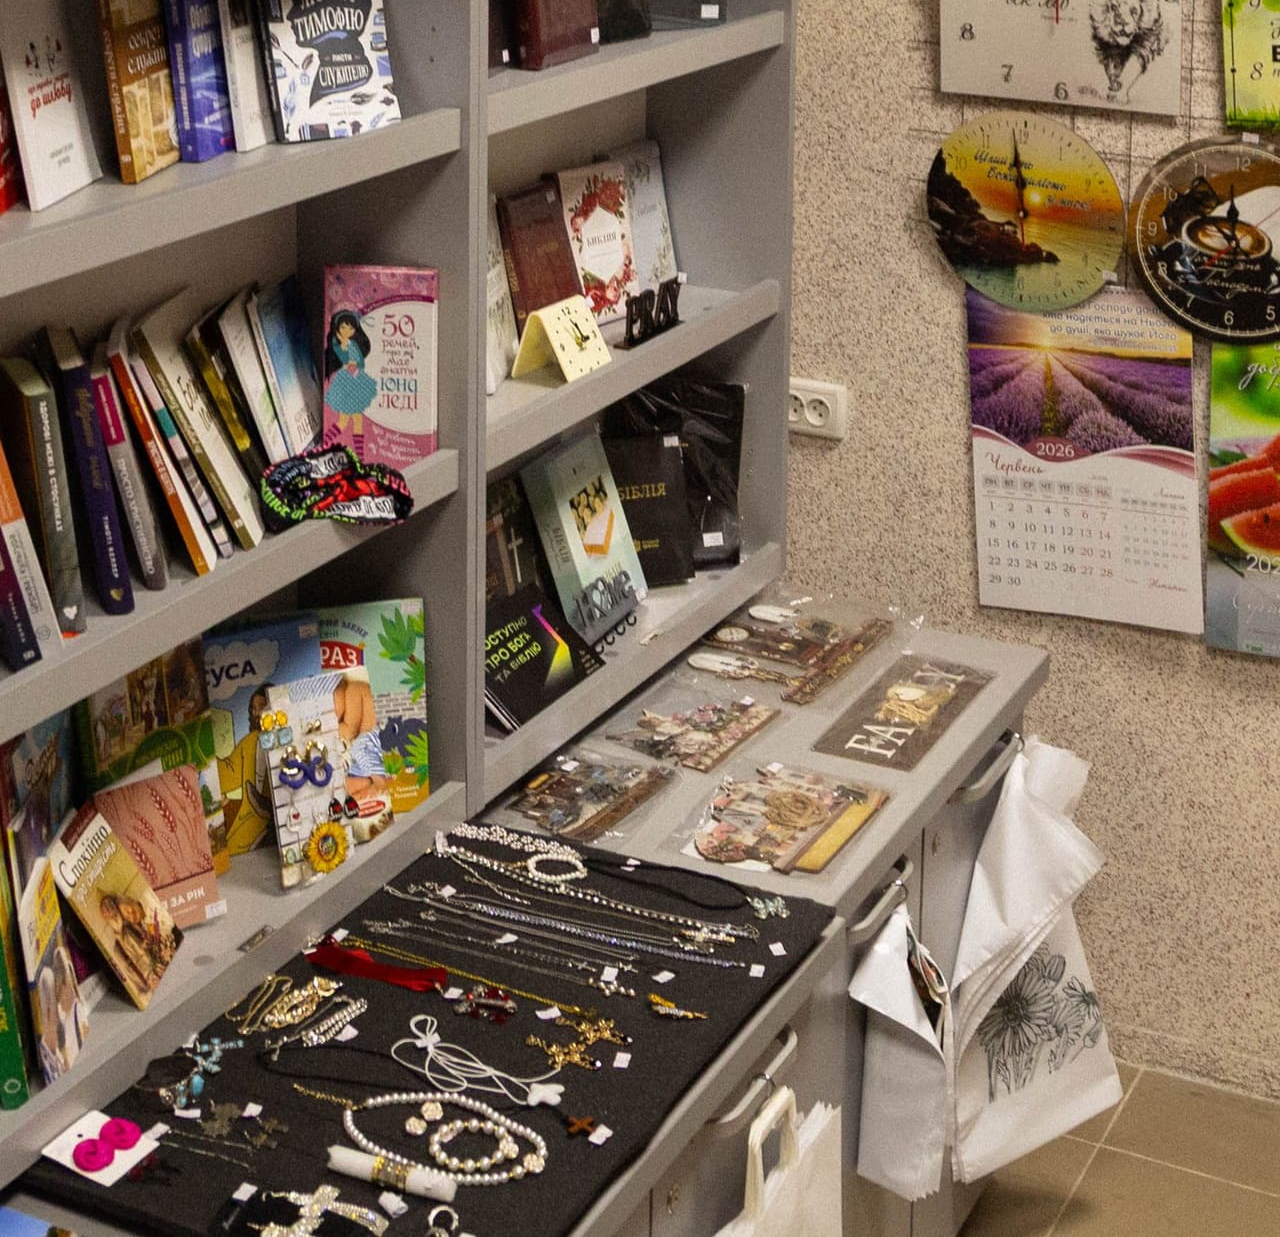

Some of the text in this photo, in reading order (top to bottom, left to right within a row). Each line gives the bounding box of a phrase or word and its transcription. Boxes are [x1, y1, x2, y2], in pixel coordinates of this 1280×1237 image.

[294, 6, 364, 41] ТИМОФІЮ
[319, 64, 369, 88] СЛУЖИТЕЛЮ
[624, 277, 682, 348] PRAY
[382, 314, 415, 338] 50
[1035, 441, 1075, 459] 2026
[988, 537, 1000, 549] 15
[1006, 539, 1018, 550] 16
[1025, 540, 1037, 552] 17
[1044, 542, 1056, 553] 18
[495, 668, 512, 683] ТА
[186, 887, 206, 903] РІК
